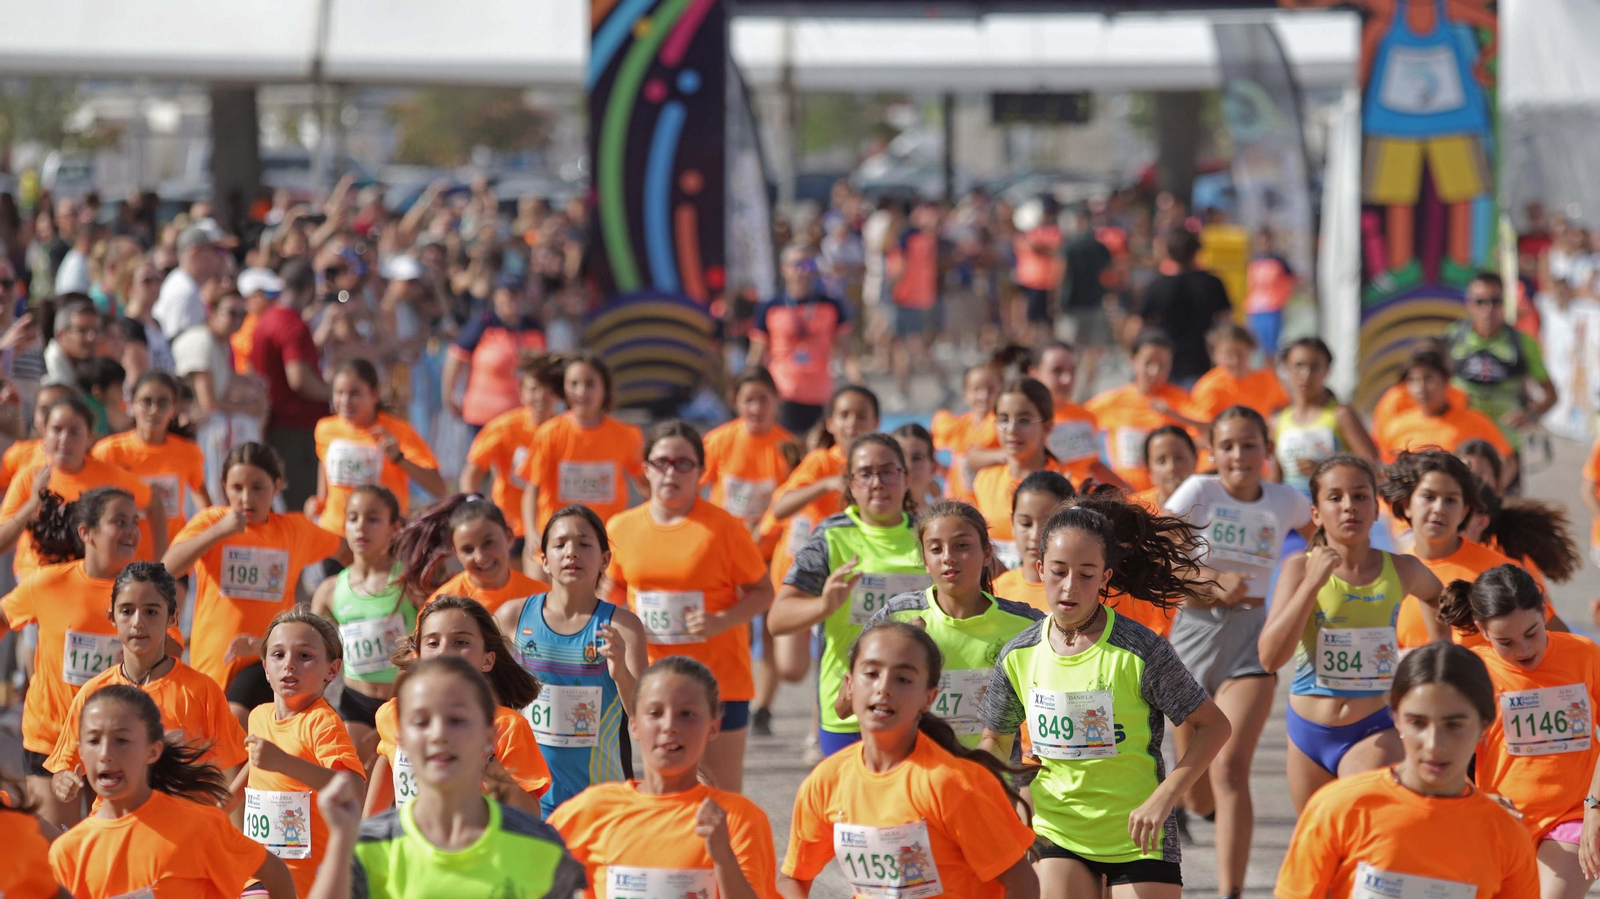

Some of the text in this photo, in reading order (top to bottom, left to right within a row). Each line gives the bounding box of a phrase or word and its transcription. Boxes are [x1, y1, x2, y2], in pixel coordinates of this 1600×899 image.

[1212, 522, 1246, 546] 661
[228, 564, 258, 585] 198
[864, 592, 898, 612] 81
[644, 610, 671, 630] 165
[346, 637, 382, 660] 1191
[70, 650, 112, 672] 1121
[1323, 650, 1363, 673] 384
[936, 693, 963, 715] 47
[1034, 694, 1043, 705] XX
[1509, 696, 1523, 707] XX
[532, 704, 551, 728] 61
[1038, 713, 1074, 740] 849
[1511, 710, 1568, 738] 1146
[247, 813, 270, 838] 199
[845, 853, 899, 880] 1153
